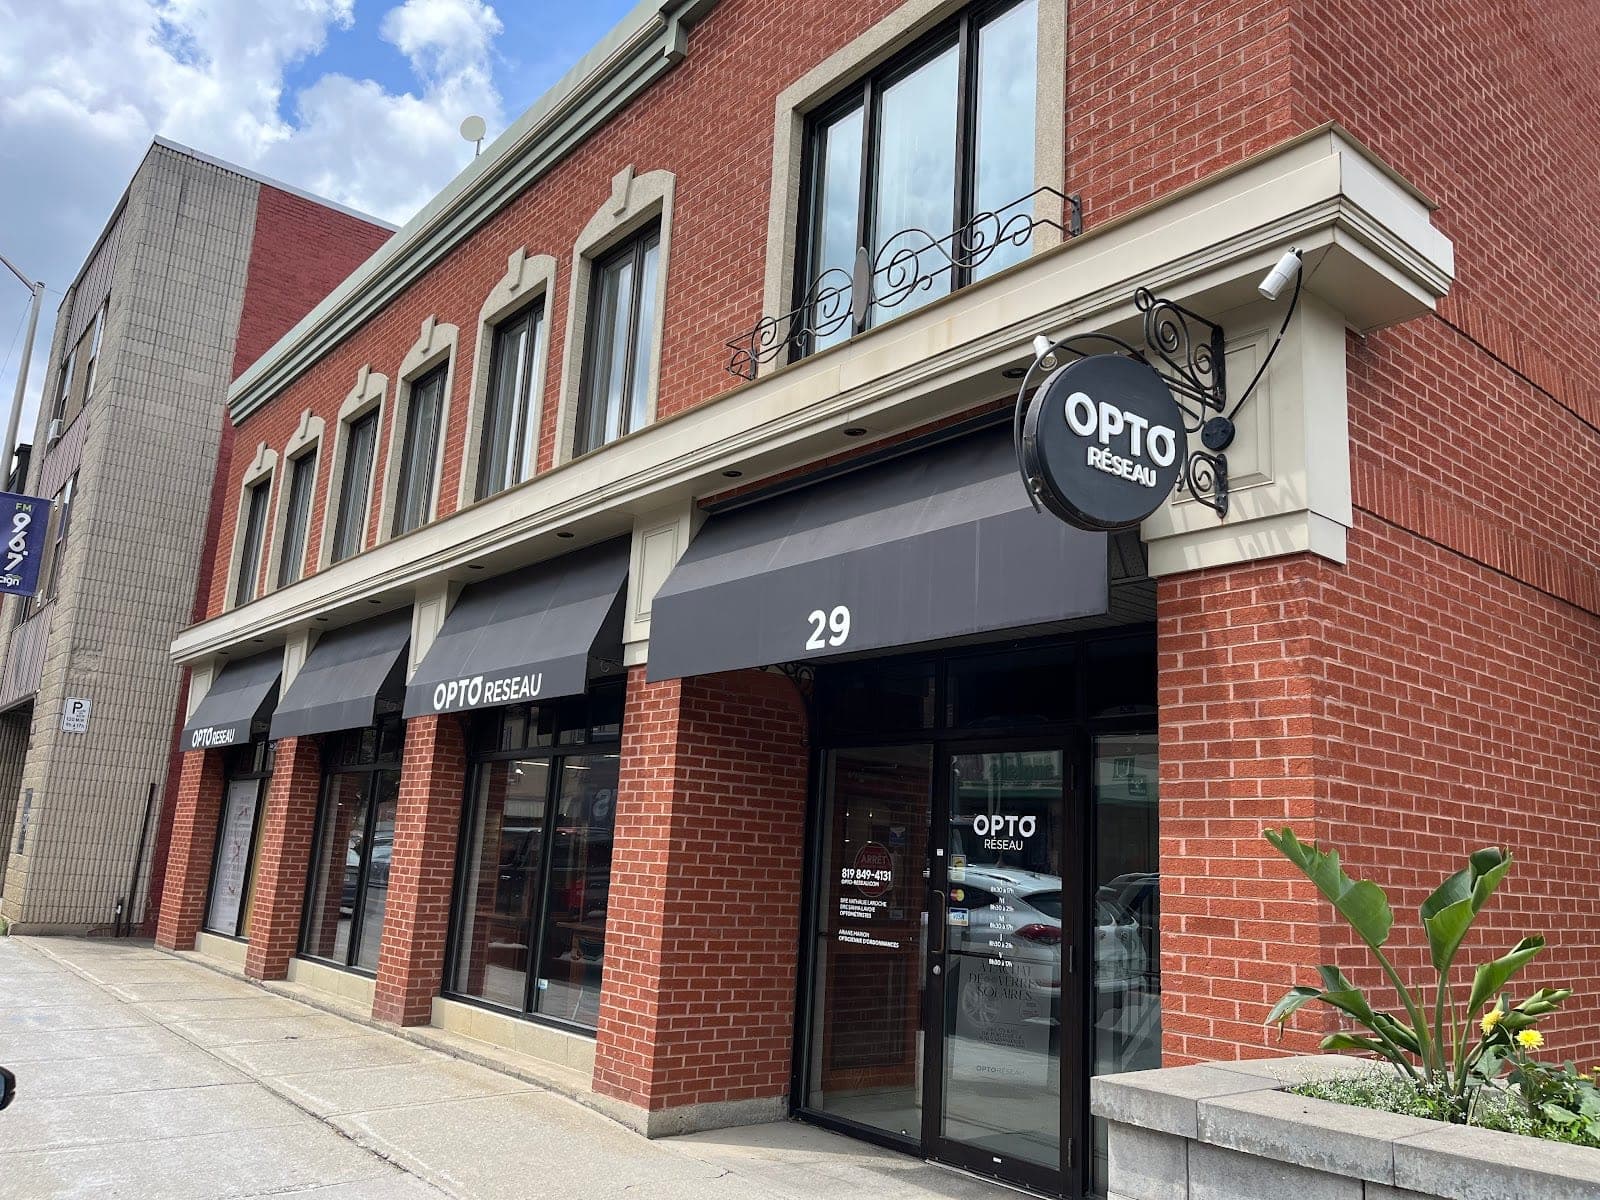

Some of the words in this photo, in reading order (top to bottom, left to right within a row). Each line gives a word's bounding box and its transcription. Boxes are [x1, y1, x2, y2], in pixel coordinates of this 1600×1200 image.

[1064, 391, 1176, 467] OPTO
[1087, 446, 1157, 488] RÉSEAU
[15, 502, 32, 512] FM
[805, 605, 851, 651] 29
[433, 676, 484, 711] OPTO
[483, 673, 543, 704] RESEAU
[72, 701, 84, 714] P
[191, 727, 213, 748] OPTO
[212, 728, 236, 745] RESEAU
[973, 814, 1037, 838] OPTO
[984, 837, 1024, 851] RÉSEAU
[841, 868, 855, 879] 819
[855, 869, 892, 881] 849-4131
